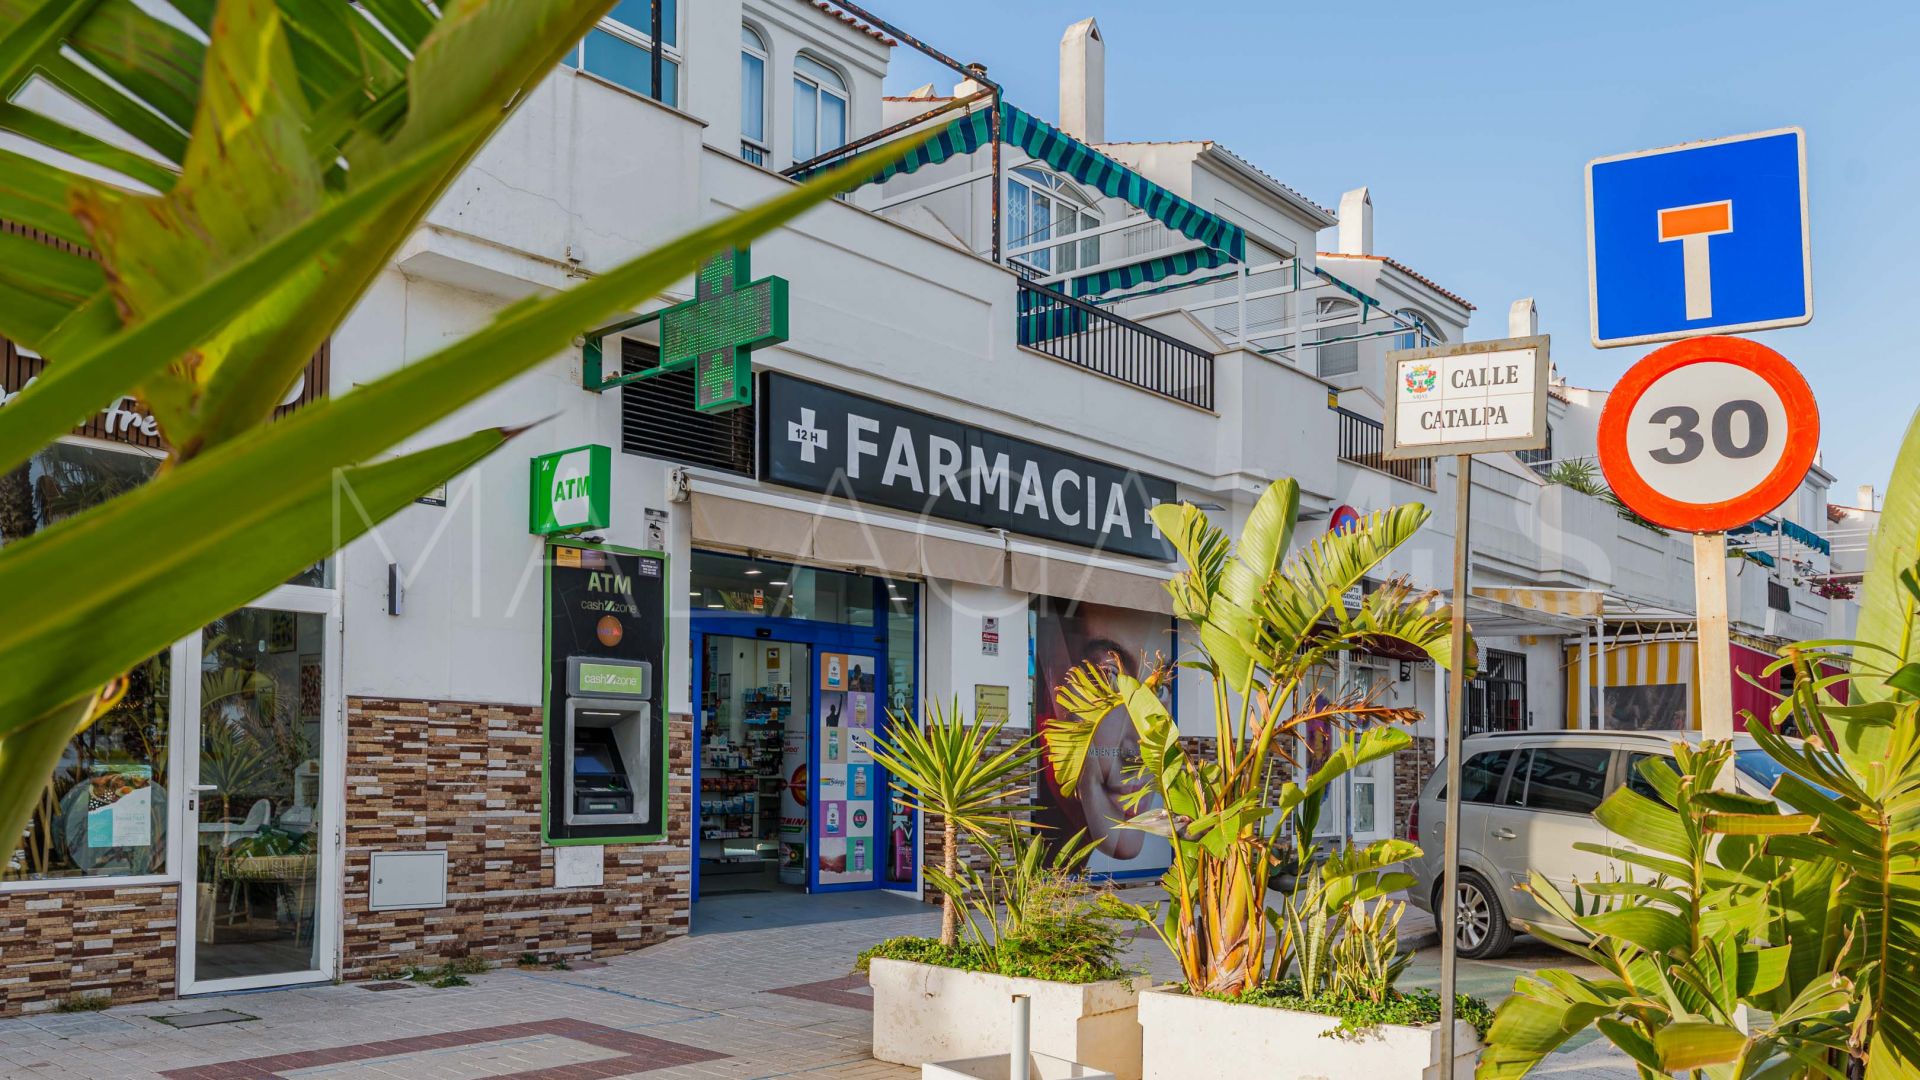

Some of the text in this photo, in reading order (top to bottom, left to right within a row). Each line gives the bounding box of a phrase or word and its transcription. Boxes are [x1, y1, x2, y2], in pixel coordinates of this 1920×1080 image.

[1451, 365, 1519, 389] CALLE
[1420, 405, 1509, 430] CATALPA
[795, 428, 818, 443] 12 H
[1648, 399, 1769, 465] 30
[846, 412, 1133, 538] FARMACIA
[554, 476, 590, 502] ATM
[587, 571, 632, 596] ATM
